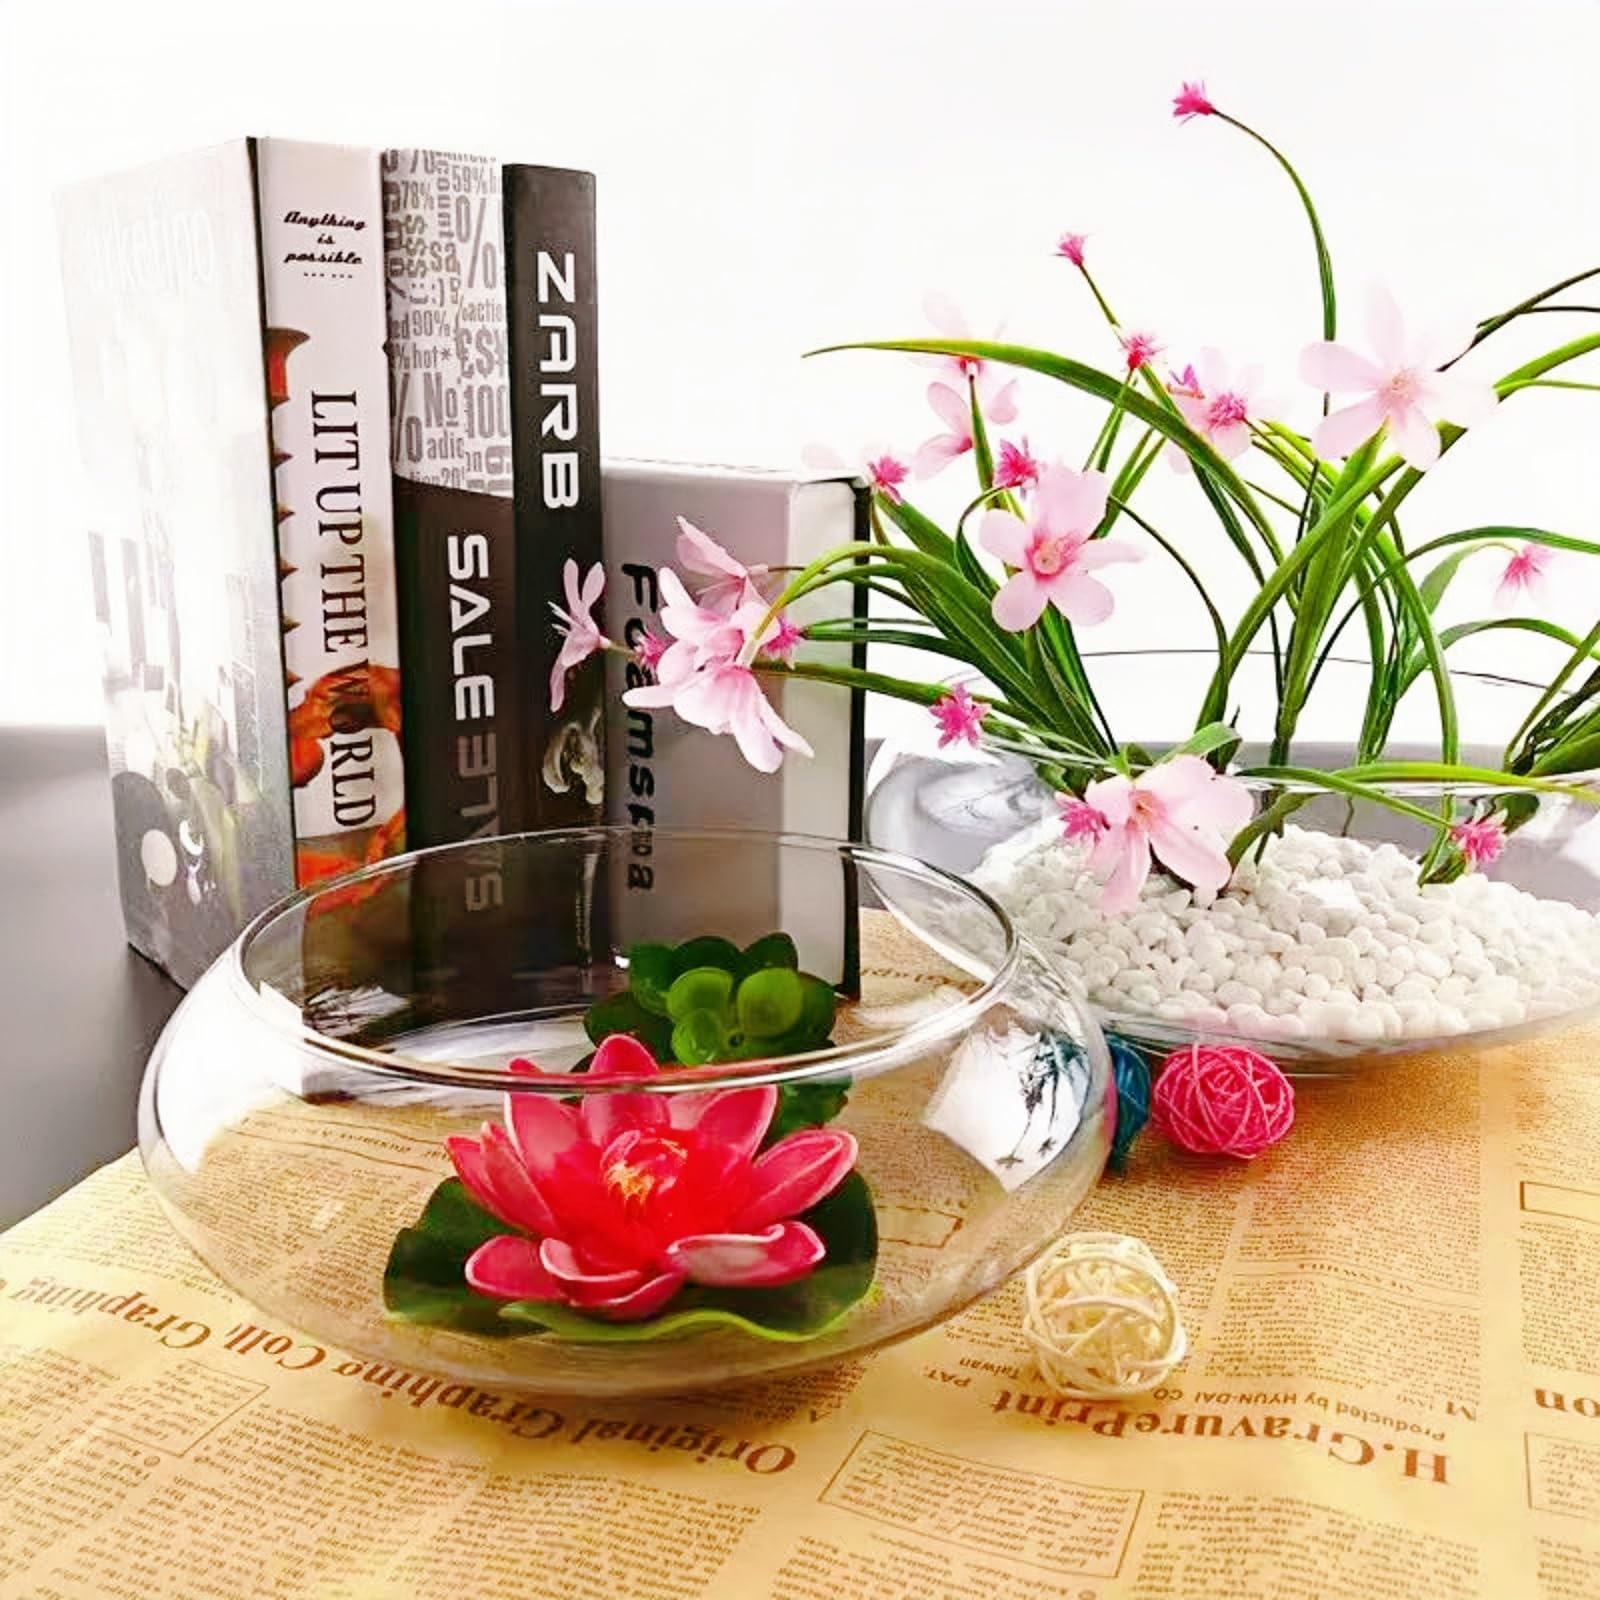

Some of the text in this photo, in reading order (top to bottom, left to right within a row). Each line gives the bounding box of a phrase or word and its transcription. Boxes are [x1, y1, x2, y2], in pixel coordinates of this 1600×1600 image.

[284, 211, 366, 231] Anything
[317, 233, 335, 244] is
[284, 251, 362, 264] possible
[537, 252, 578, 509] ZARB
[313, 391, 376, 827] LIT UP THE WORLD
[448, 534, 495, 721] SALE
[12, 1276, 211, 1349] Graphing
[331, 1360, 565, 1440] Graphing
[1195, 1389, 1297, 1407] HYUN-DAI
[1306, 1392, 1328, 1412] by
[1334, 1401, 1445, 1441] Producted
[570, 1417, 796, 1475] Original
